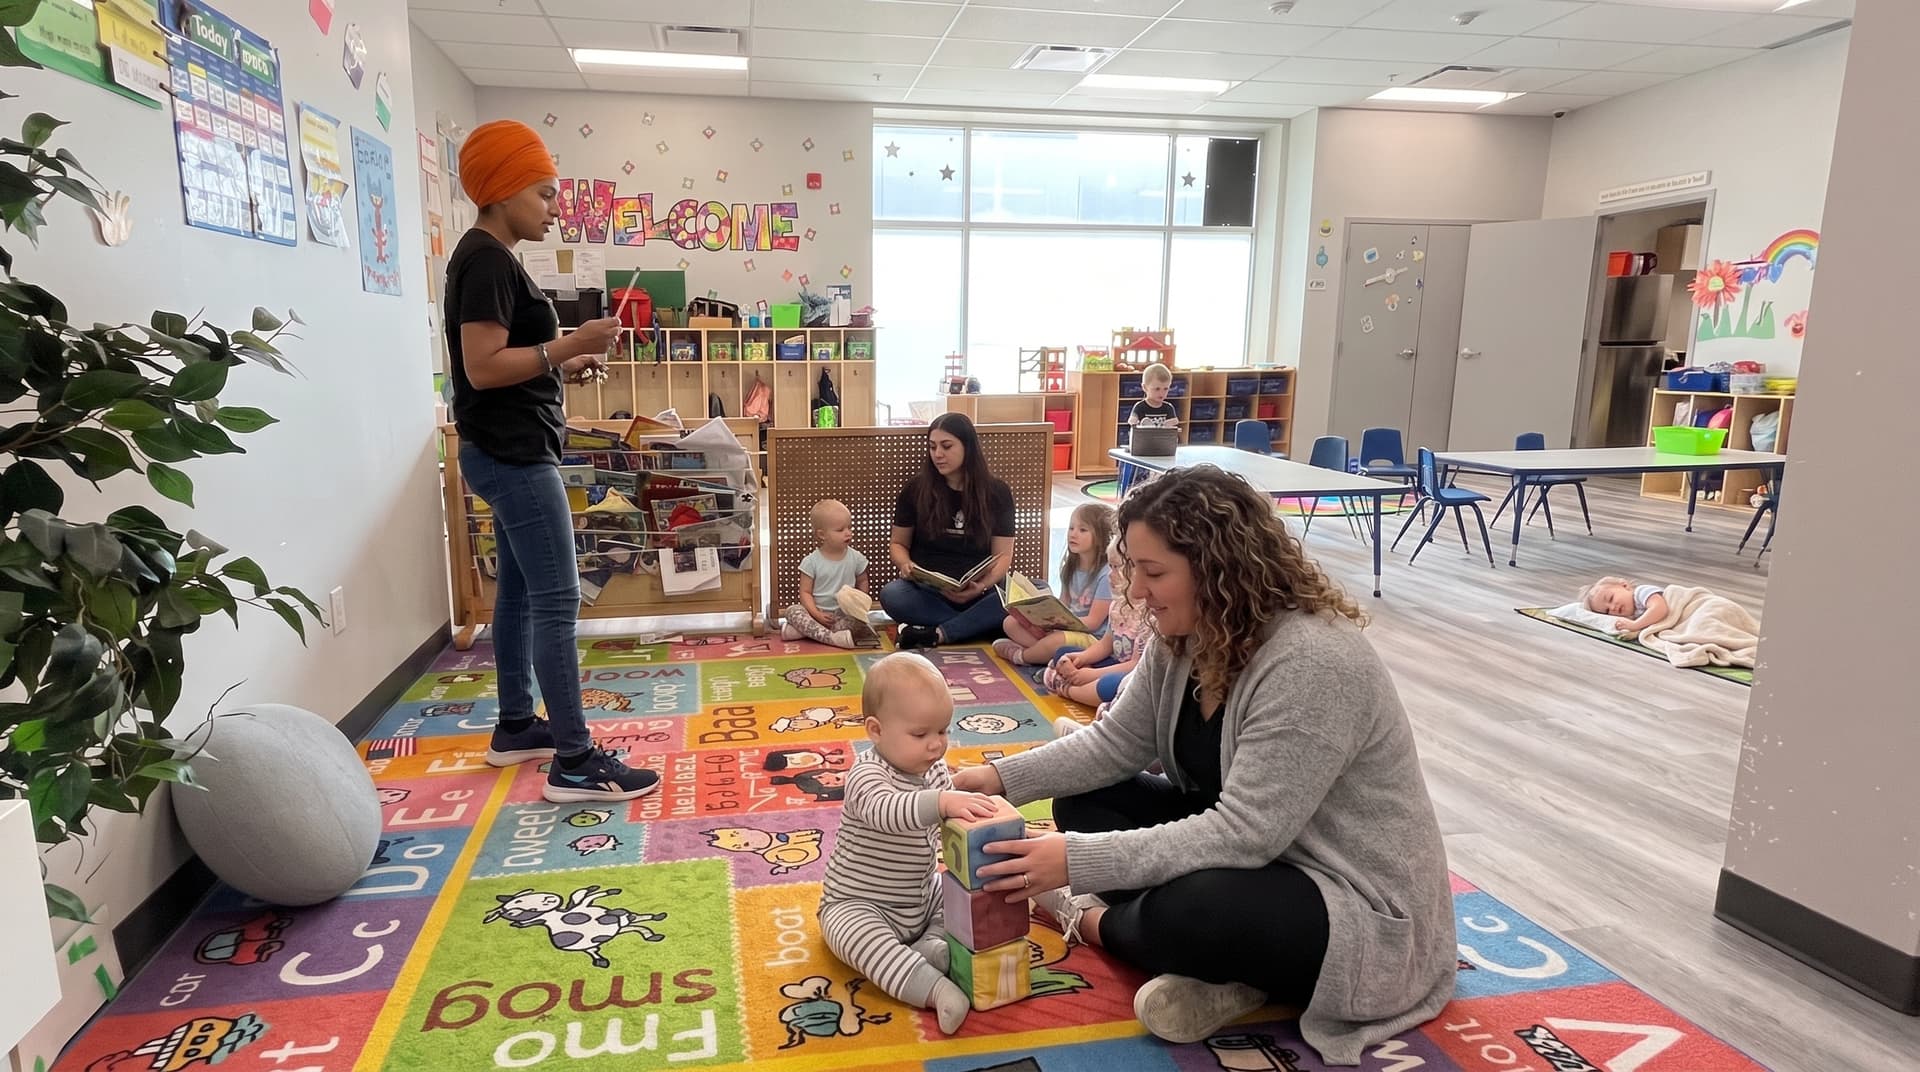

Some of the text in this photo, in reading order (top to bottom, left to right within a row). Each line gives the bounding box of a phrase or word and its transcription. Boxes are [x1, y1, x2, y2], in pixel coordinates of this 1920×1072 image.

[192, 14, 228, 56] Today
[558, 178, 800, 252] WELCOME
[699, 705, 759, 745] Baa
[764, 905, 811, 967] boat
[160, 972, 207, 1007] car
[420, 969, 718, 1032] smog
[492, 1009, 719, 1069] Fmo
